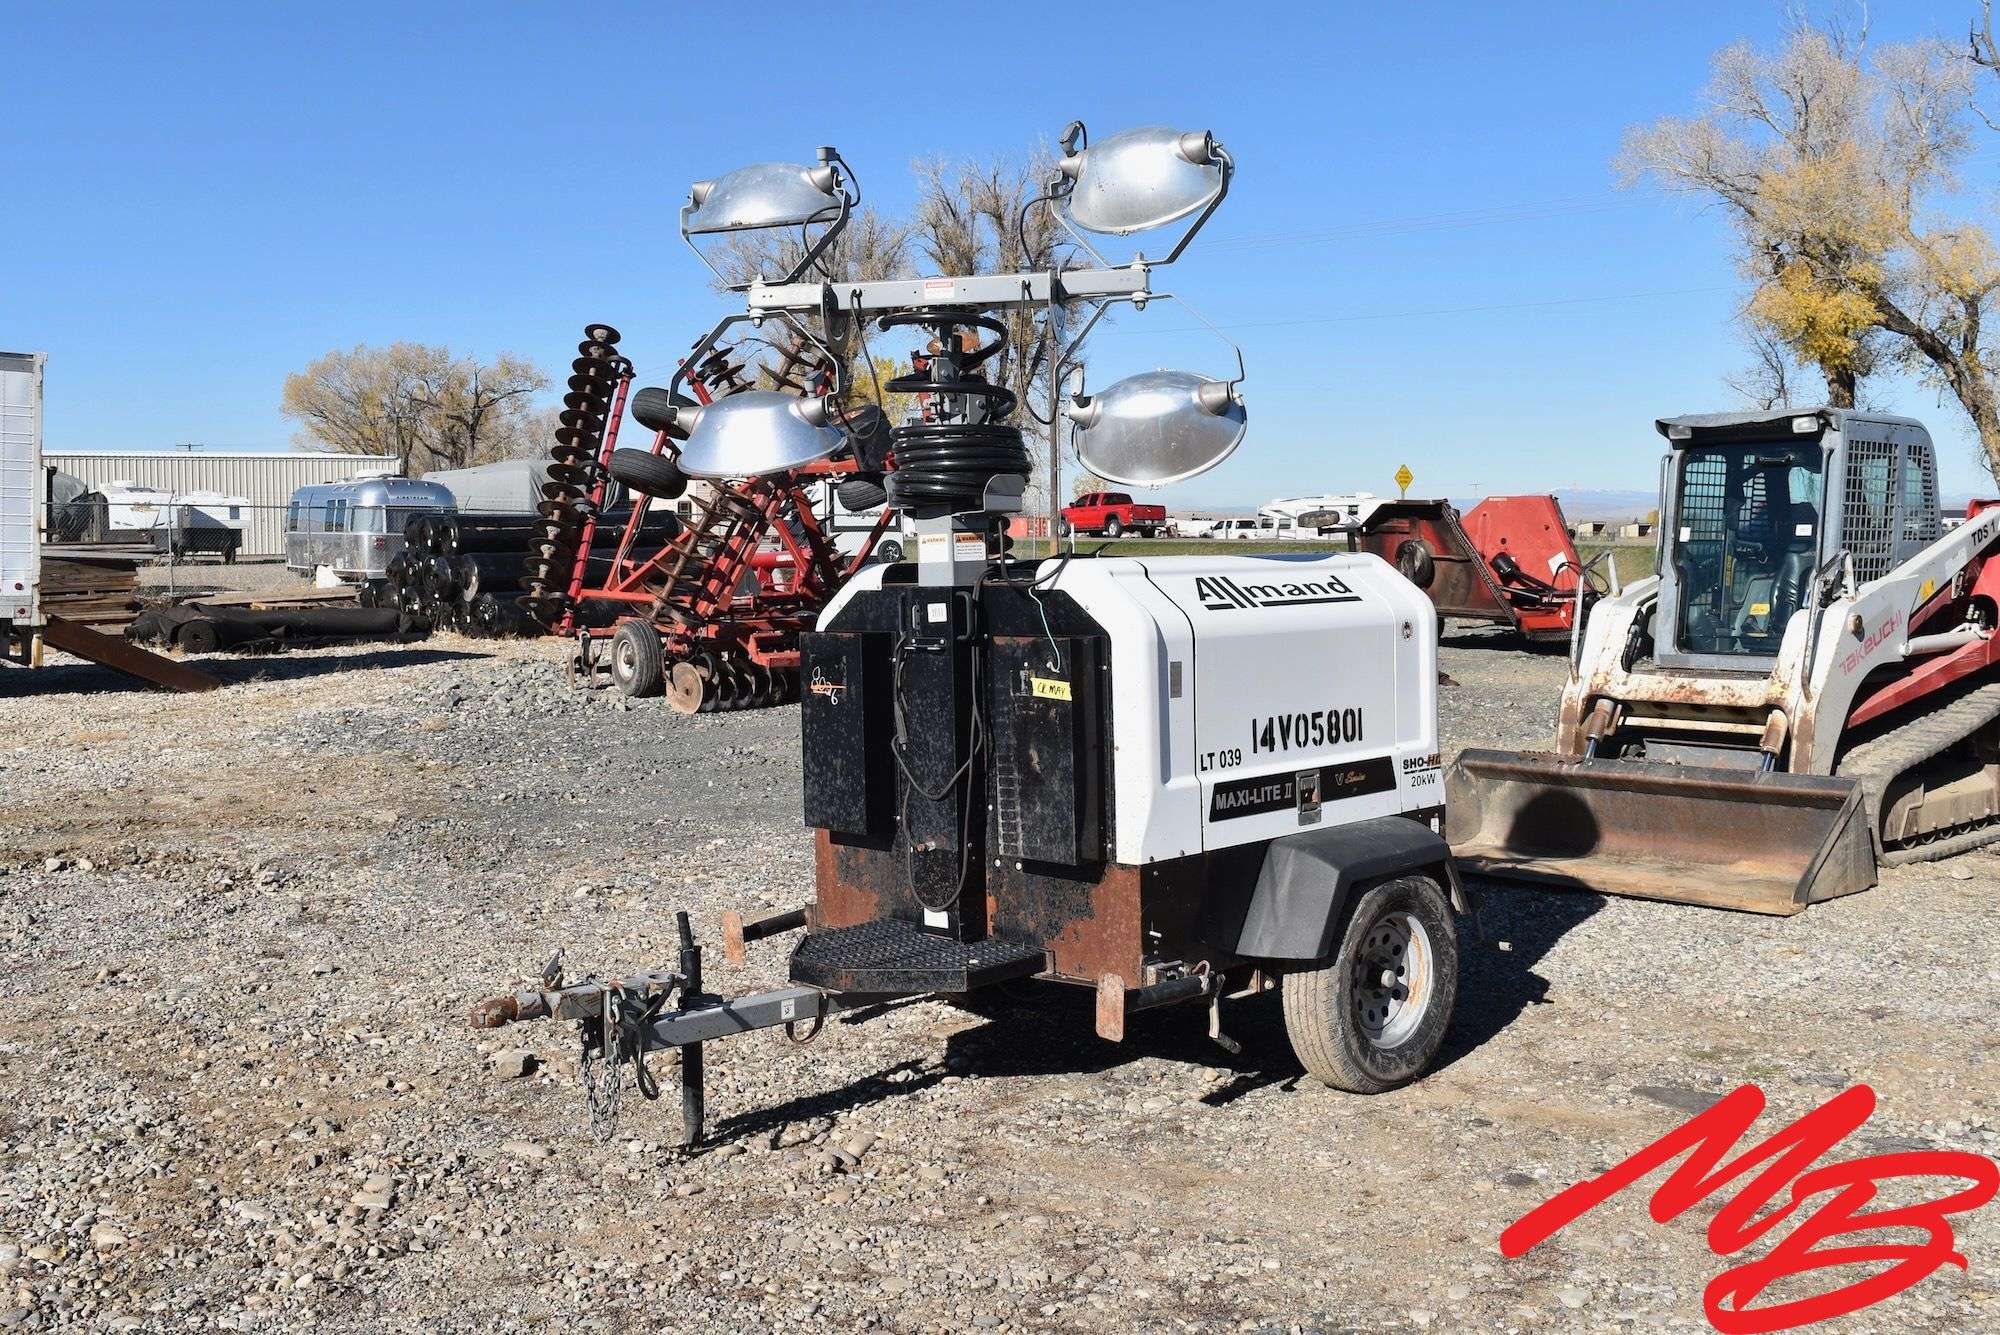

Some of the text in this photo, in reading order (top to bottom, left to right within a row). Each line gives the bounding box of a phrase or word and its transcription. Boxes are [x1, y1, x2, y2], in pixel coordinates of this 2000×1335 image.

[1971, 524, 1989, 546] TDS
[1195, 574, 1353, 608] Allmand
[1252, 707, 1363, 754] 14V05801
[1200, 748, 1242, 771] LT 039
[1411, 773, 1436, 788] 20kW
[1216, 784, 1281, 810] MAXI-LITE
